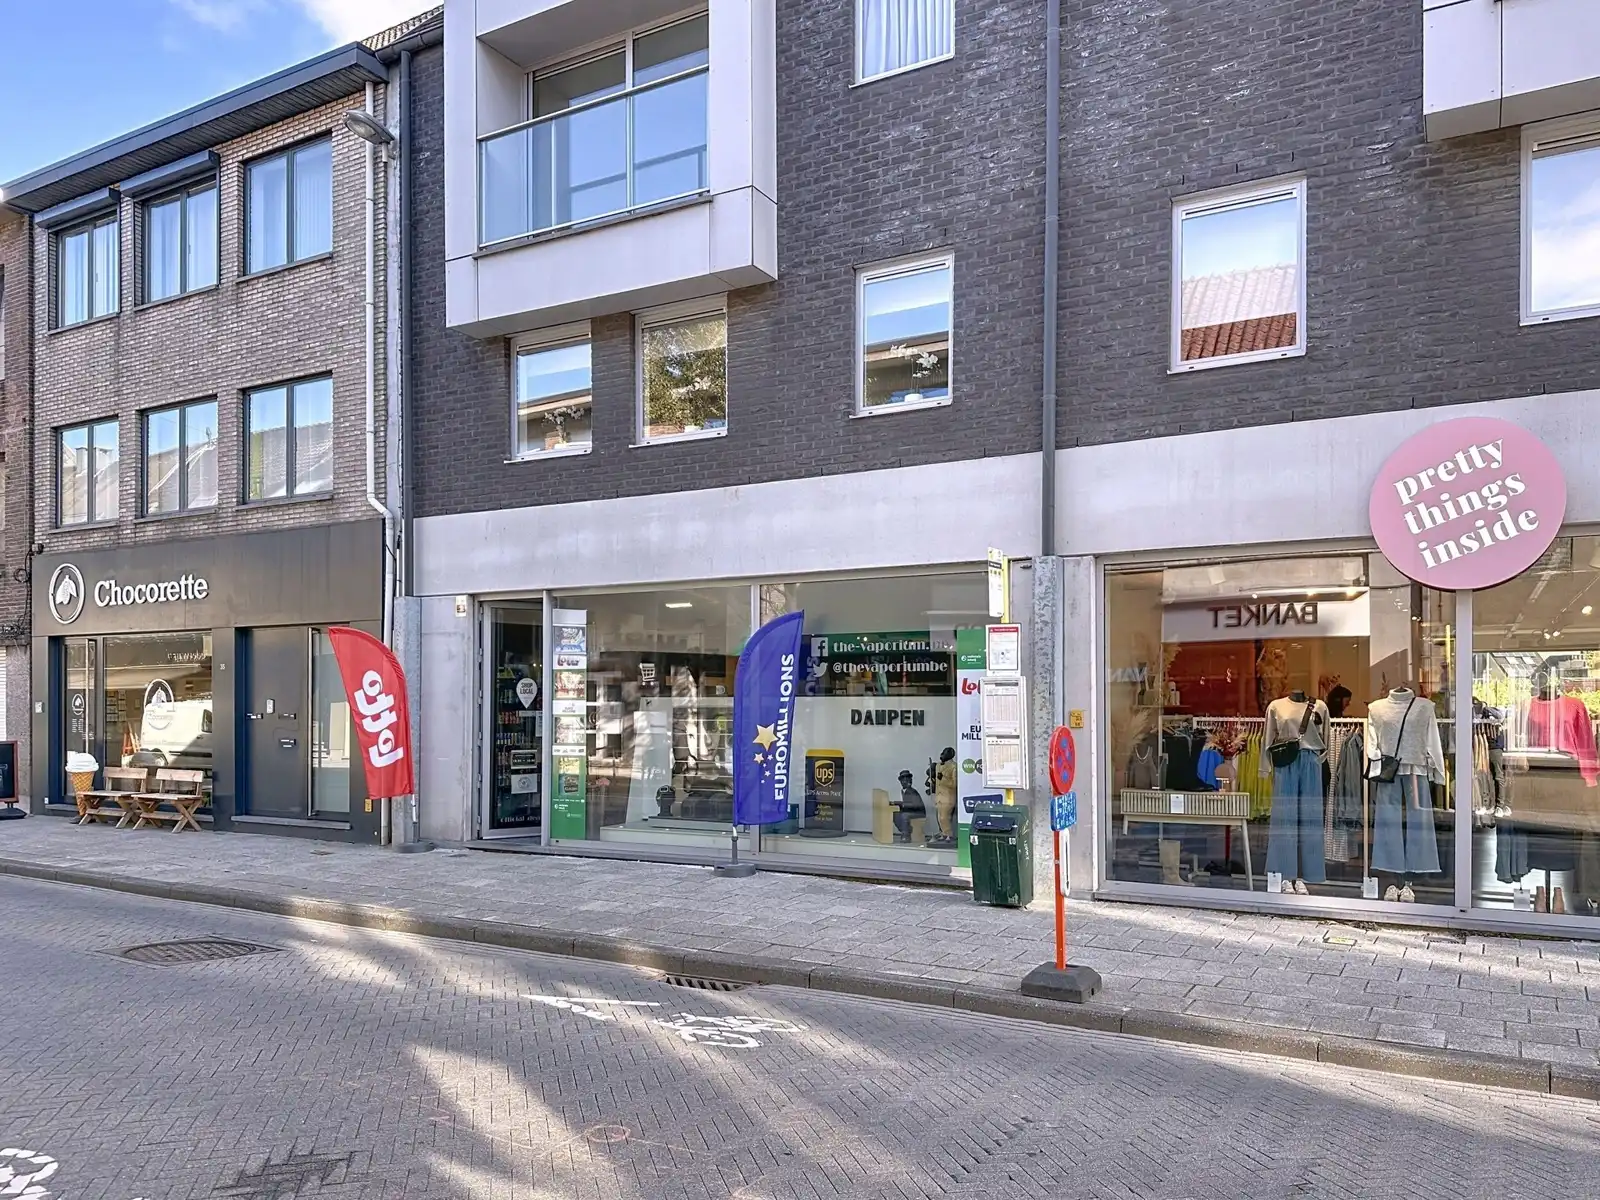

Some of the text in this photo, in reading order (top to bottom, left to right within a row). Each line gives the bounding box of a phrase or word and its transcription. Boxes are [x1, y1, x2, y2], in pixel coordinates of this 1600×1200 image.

[1393, 439, 1503, 505] pretty
[1403, 473, 1526, 535] things
[1418, 508, 1539, 569] inside
[94, 574, 208, 607] Chocorette
[833, 661, 948, 674] @thevaporiumbe
[774, 653, 794, 800] EUROMILLIONS
[850, 709, 925, 726] DAMPEN
[970, 725, 981, 733] EU
[816, 768, 833, 782] ups
